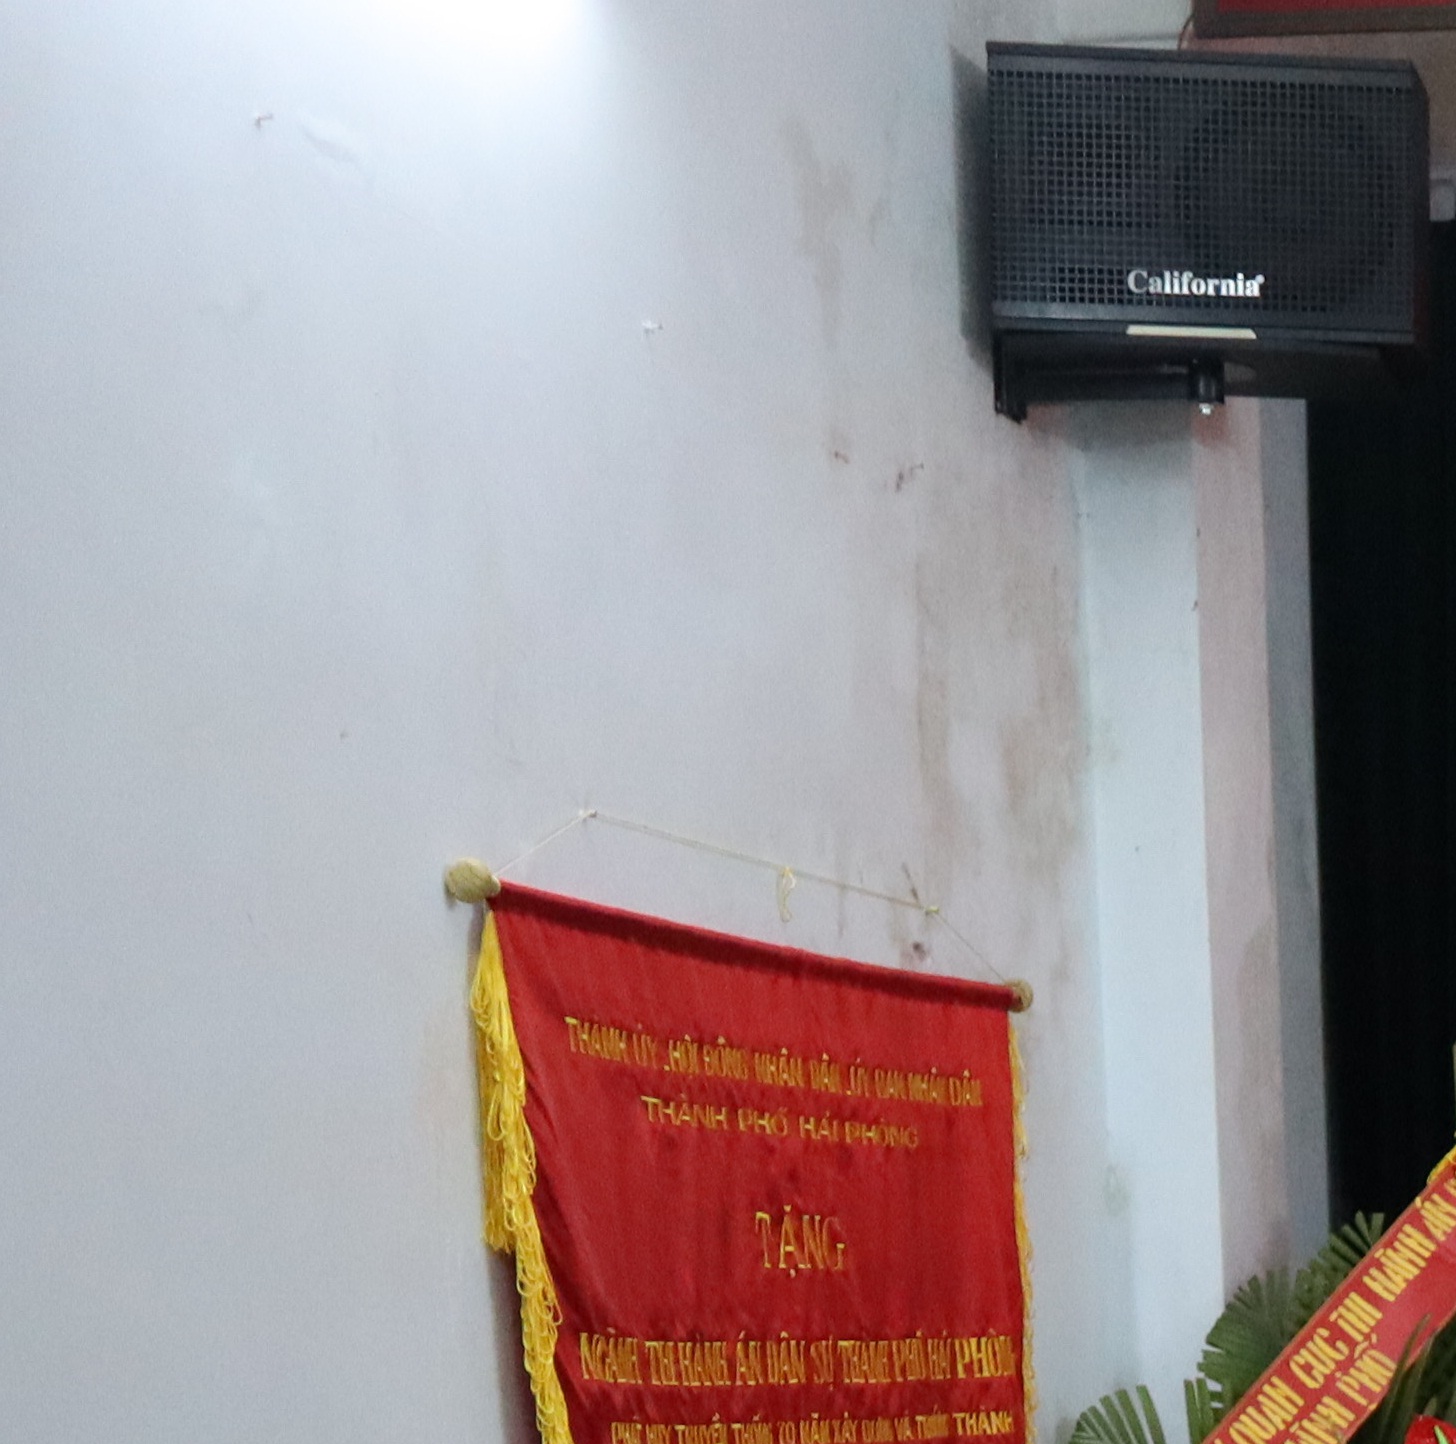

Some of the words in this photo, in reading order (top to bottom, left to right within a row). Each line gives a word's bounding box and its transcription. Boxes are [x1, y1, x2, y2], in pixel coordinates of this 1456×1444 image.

[1127, 269, 1261, 299] California
[755, 1203, 846, 1279] TẶNG
[735, 1330, 764, 1385] ÁN
